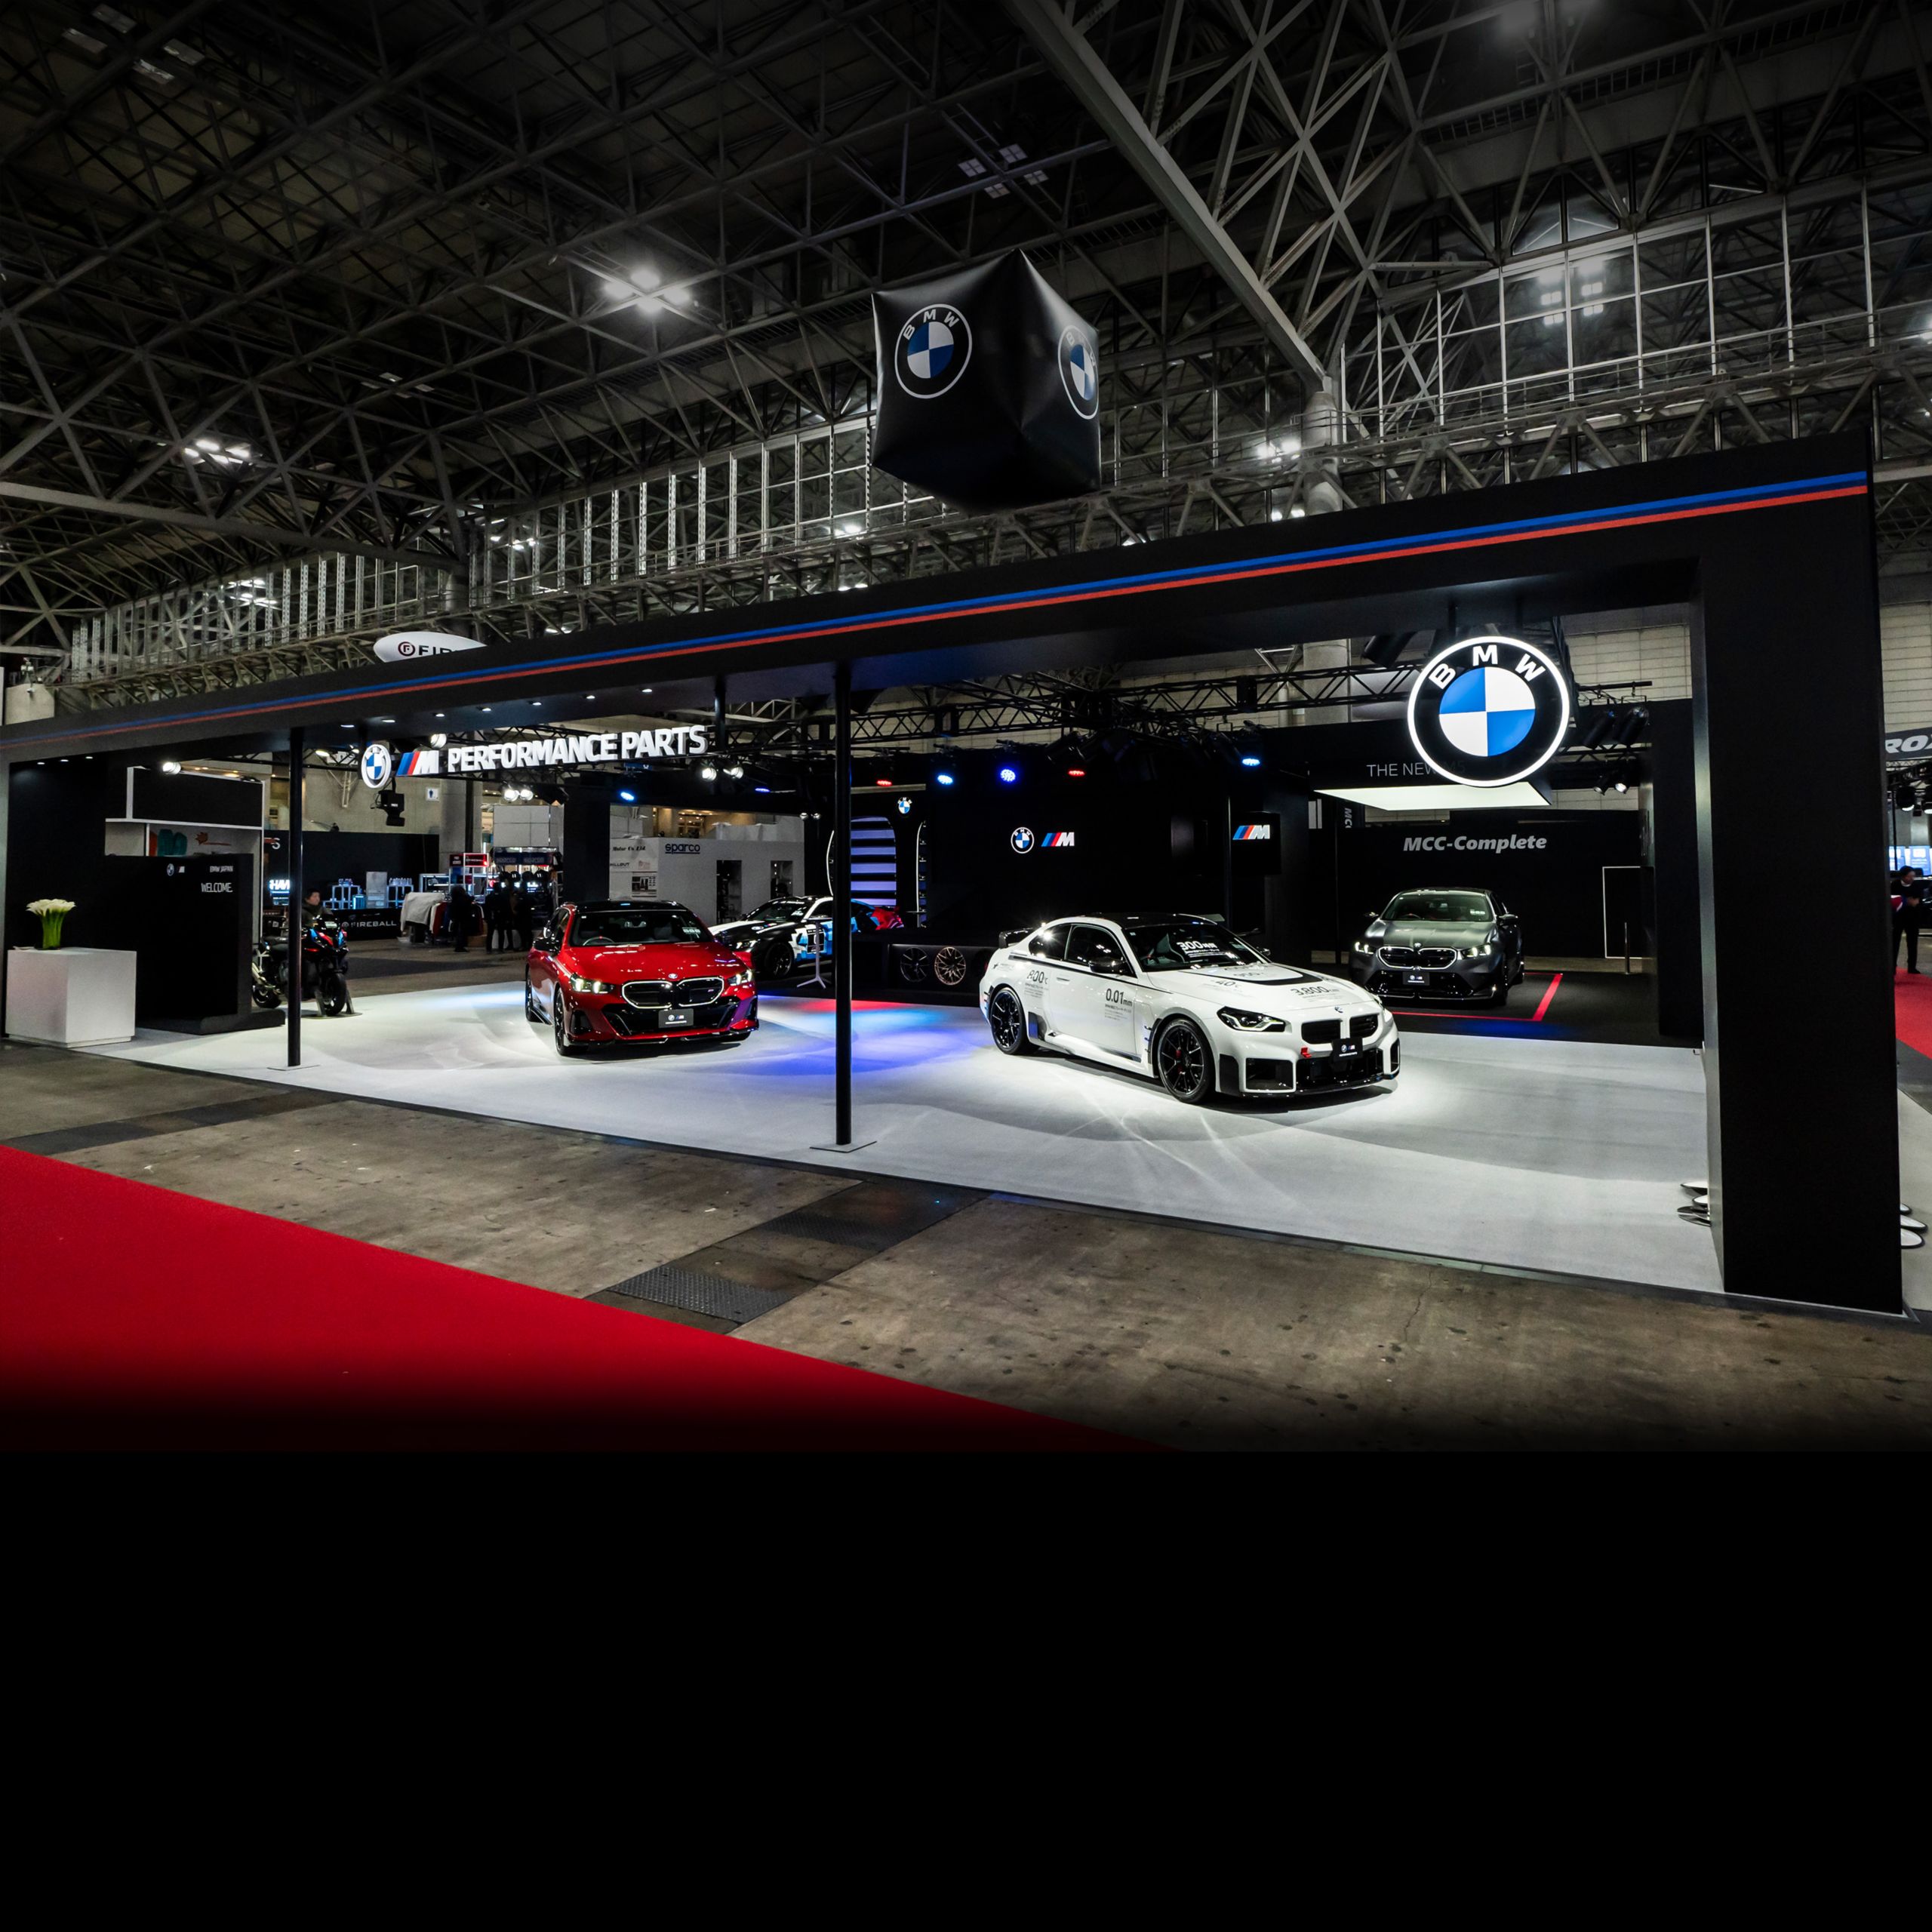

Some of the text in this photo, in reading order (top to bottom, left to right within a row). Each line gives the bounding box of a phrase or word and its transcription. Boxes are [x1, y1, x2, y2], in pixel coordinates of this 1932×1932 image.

[902, 309, 960, 340] BMW
[418, 645, 459, 655] FI
[1429, 645, 1546, 690] BMW
[448, 733, 617, 773] PERFORMANCE
[622, 724, 708, 758] PARTS
[1367, 763, 1398, 777] THE
[665, 843, 700, 854] sparco
[1403, 834, 1547, 854] MCC-Complete
[352, 919, 398, 928] FIREBALL
[1106, 988, 1133, 1007] 0.01mm
